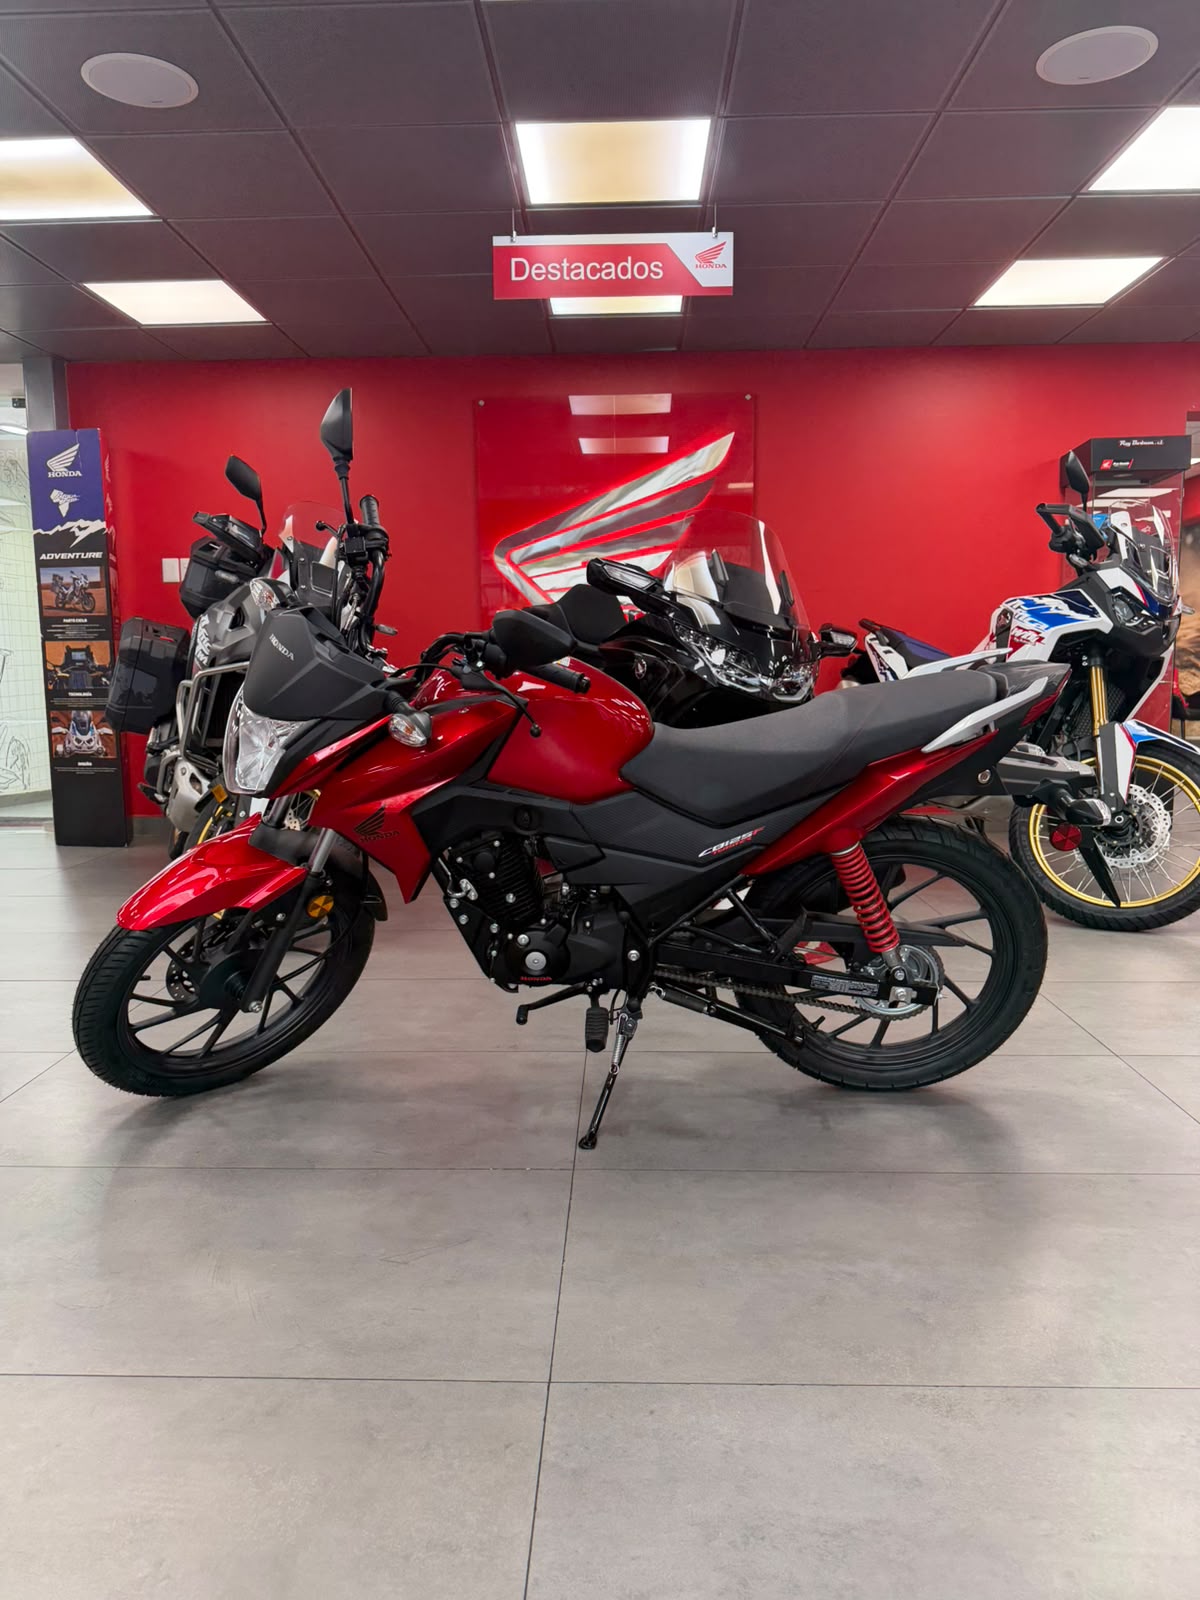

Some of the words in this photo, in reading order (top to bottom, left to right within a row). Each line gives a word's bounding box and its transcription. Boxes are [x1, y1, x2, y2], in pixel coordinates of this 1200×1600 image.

[510, 256, 663, 281] Destacados
[40, 552, 103, 560] ADVENTURE
[269, 633, 294, 661] HONDA
[361, 830, 400, 842] HONDA
